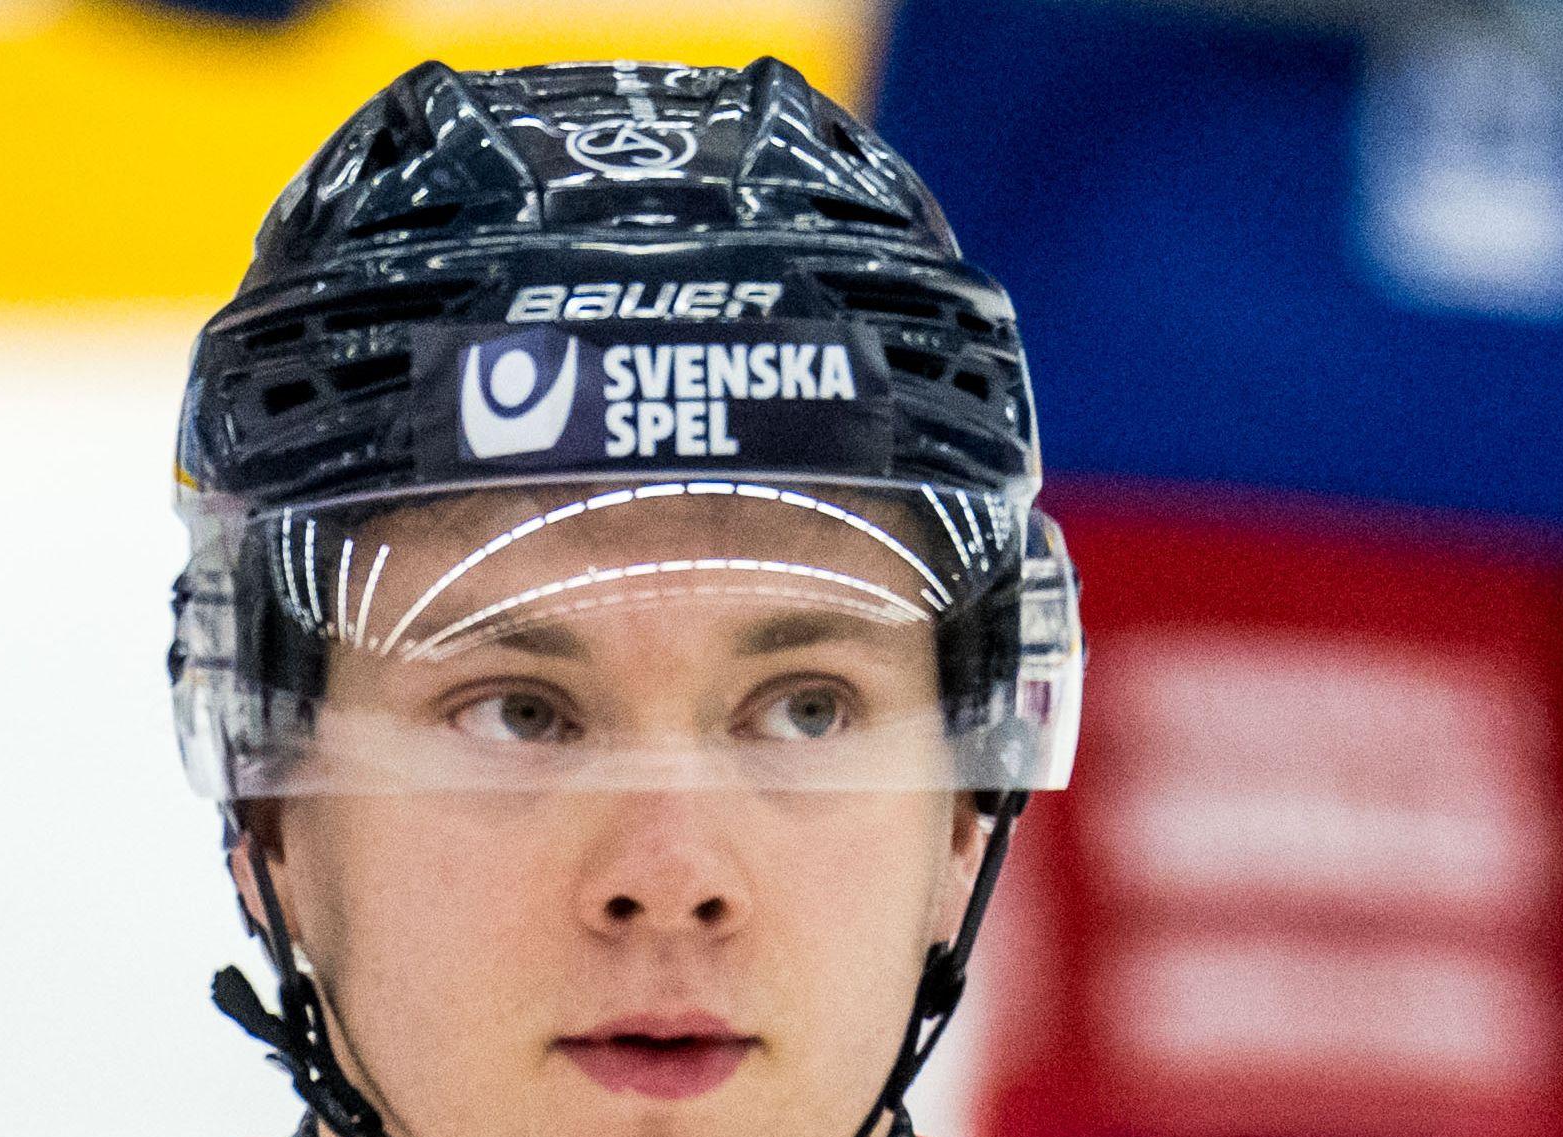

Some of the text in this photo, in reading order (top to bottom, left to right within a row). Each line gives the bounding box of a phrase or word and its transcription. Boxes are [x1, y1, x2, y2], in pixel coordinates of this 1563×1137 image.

[506, 282, 782, 322] BAUER
[603, 344, 855, 401] SVENSKA
[605, 400, 738, 457] SPEL
